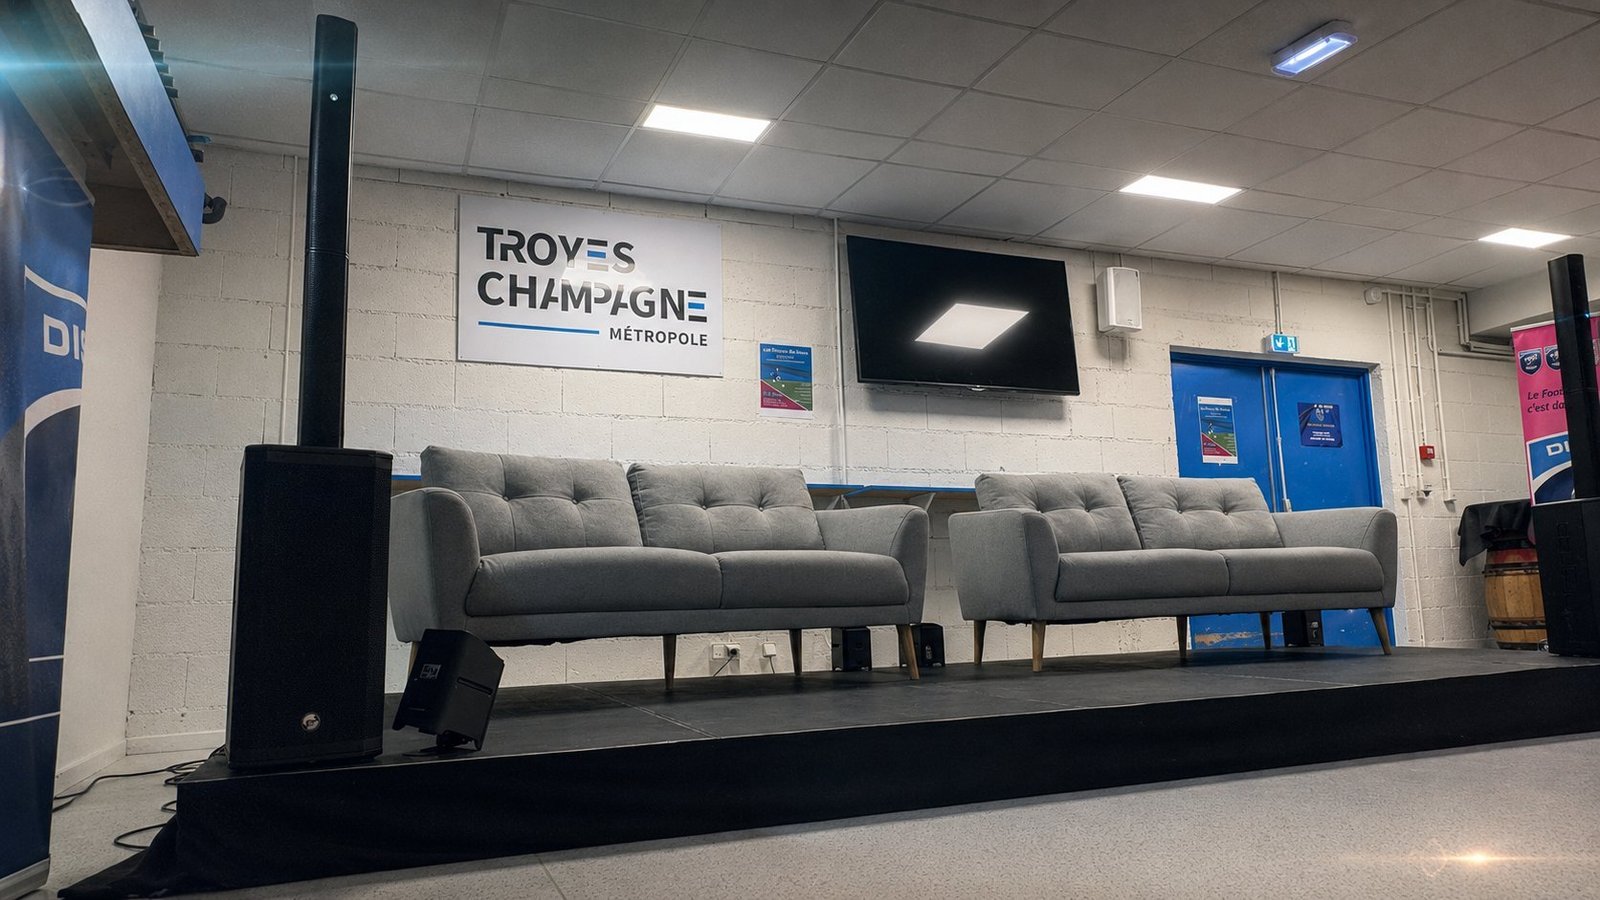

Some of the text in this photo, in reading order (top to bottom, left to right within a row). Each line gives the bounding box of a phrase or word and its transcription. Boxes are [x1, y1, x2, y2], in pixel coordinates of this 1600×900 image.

[477, 226, 636, 273] TROYES
[477, 271, 708, 322] CHAMPAGNE
[609, 325, 708, 346] MÉTROPOLE
[1527, 391, 1539, 400] Le
[1527, 403, 1550, 413] c'est
